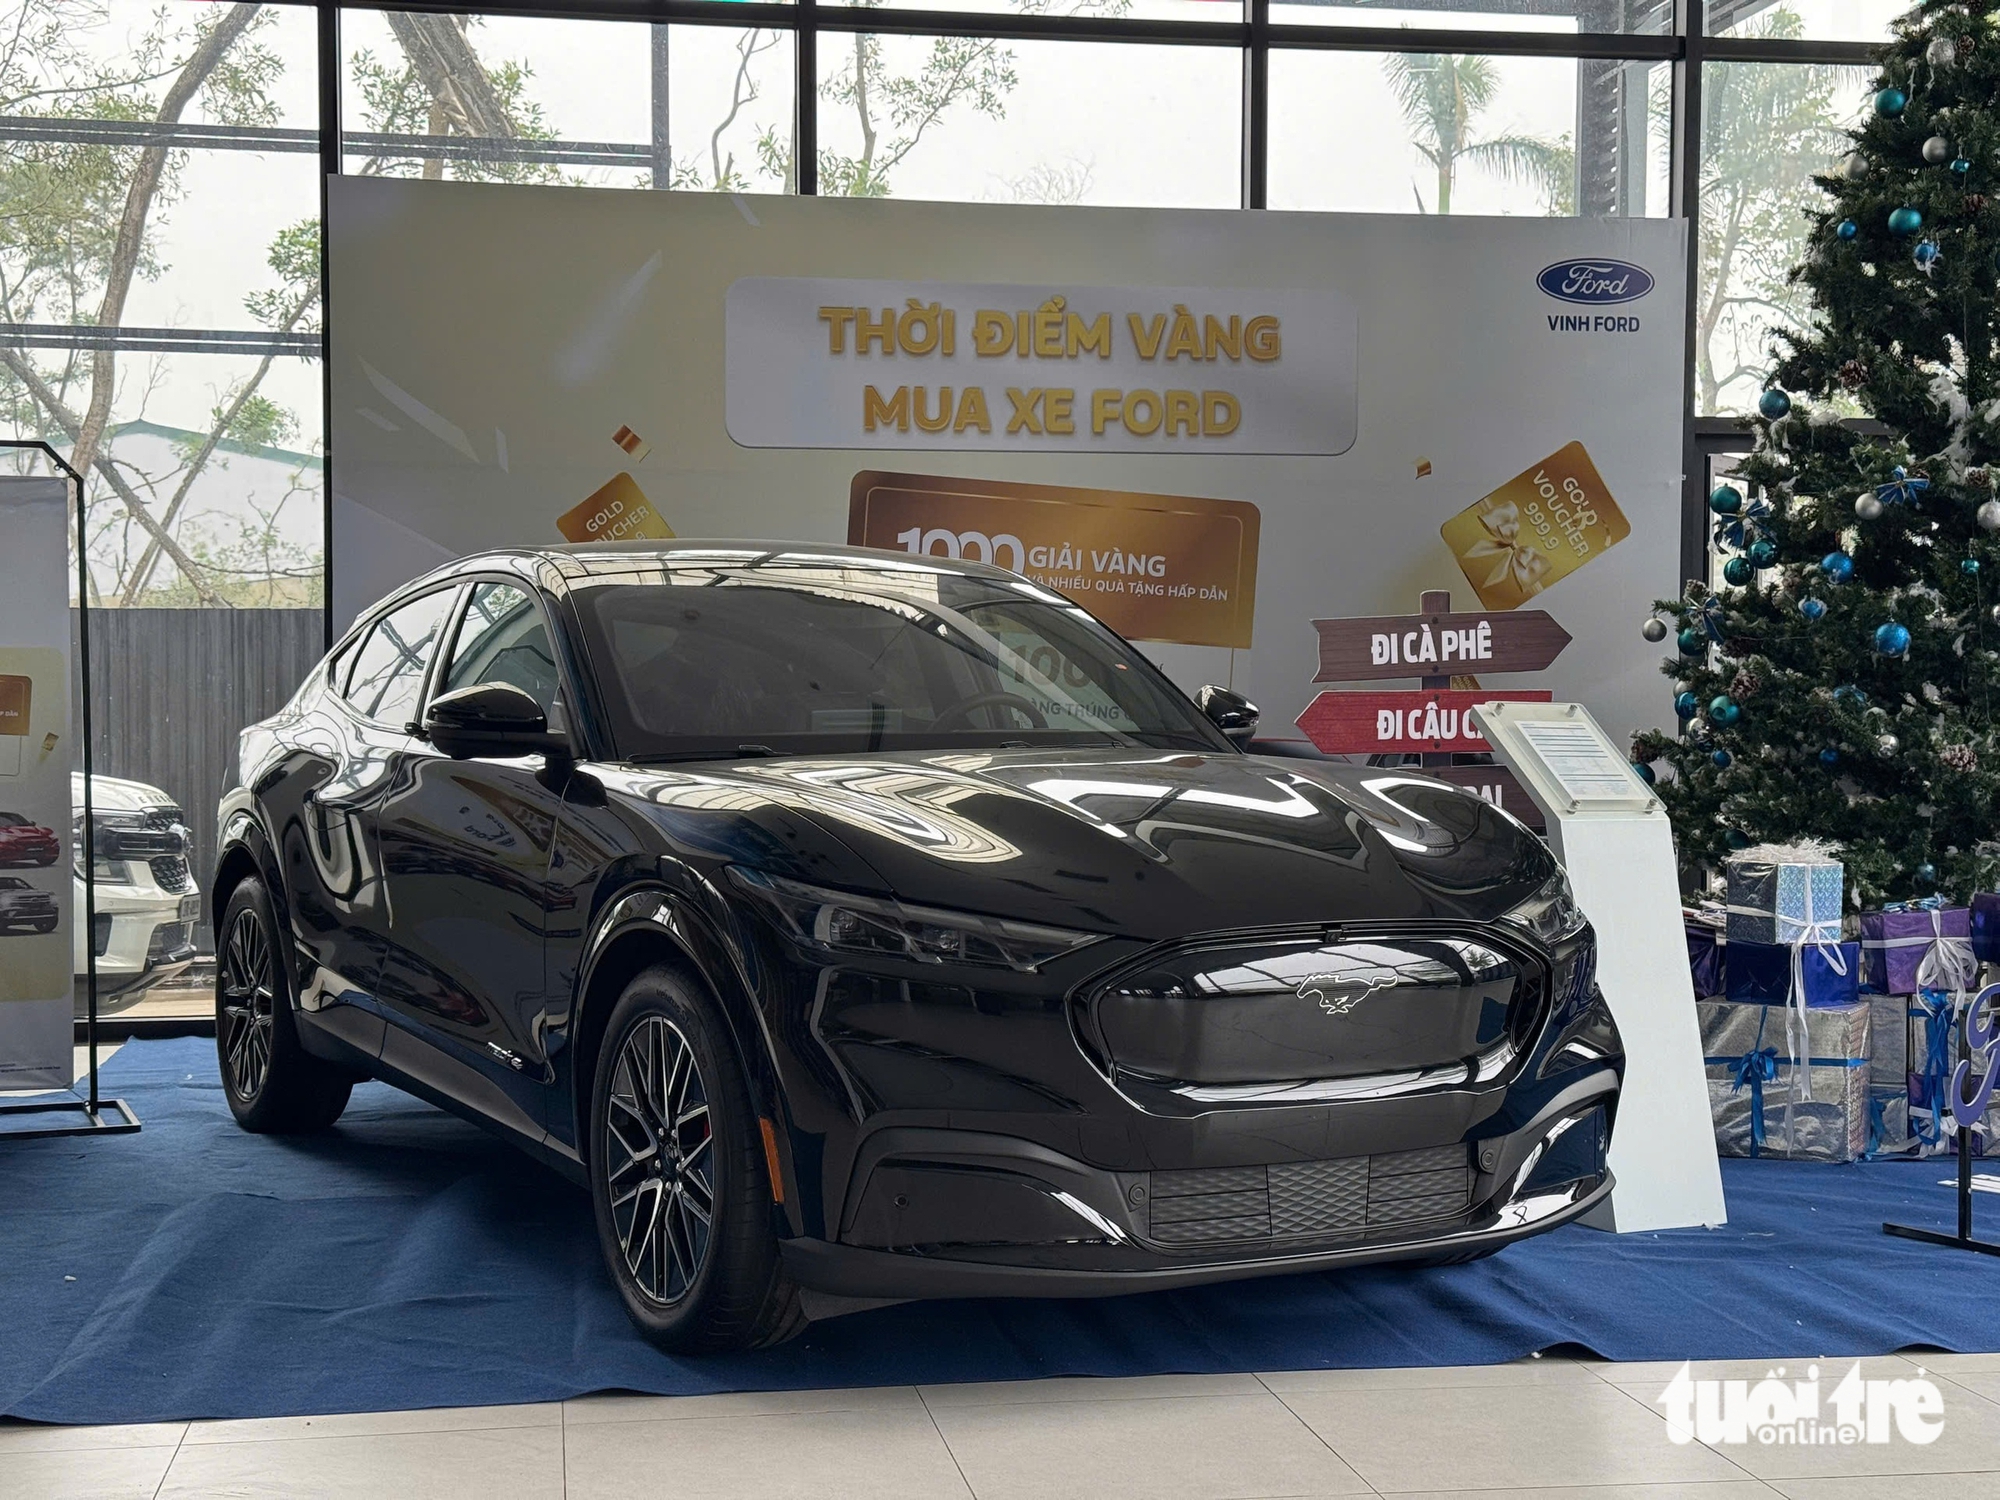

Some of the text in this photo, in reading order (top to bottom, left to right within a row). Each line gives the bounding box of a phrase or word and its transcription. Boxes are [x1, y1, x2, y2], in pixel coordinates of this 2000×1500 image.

[1561, 265, 1628, 296] Ford
[818, 295, 1281, 360] THỜI ĐIỂM VÀNG
[1547, 315, 1640, 333] VINH FORD
[864, 385, 1241, 437] MUA XE FORD
[586, 500, 624, 533] GOLD
[594, 505, 650, 542] UCHER
[1523, 502, 1560, 550] 999.9
[1533, 469, 1590, 558] VOUCHER
[1029, 542, 1082, 570] GIẢI
[1091, 548, 1166, 578] VÀNG
[1095, 577, 1125, 593] QUÀ
[1128, 581, 1164, 598] TẶNG
[1168, 583, 1196, 599] HẤP
[1371, 621, 1493, 665] ĐI CÀ PHÊ
[1376, 702, 1484, 740] ĐI CÂU C
[1463, 785, 1502, 809] AI
